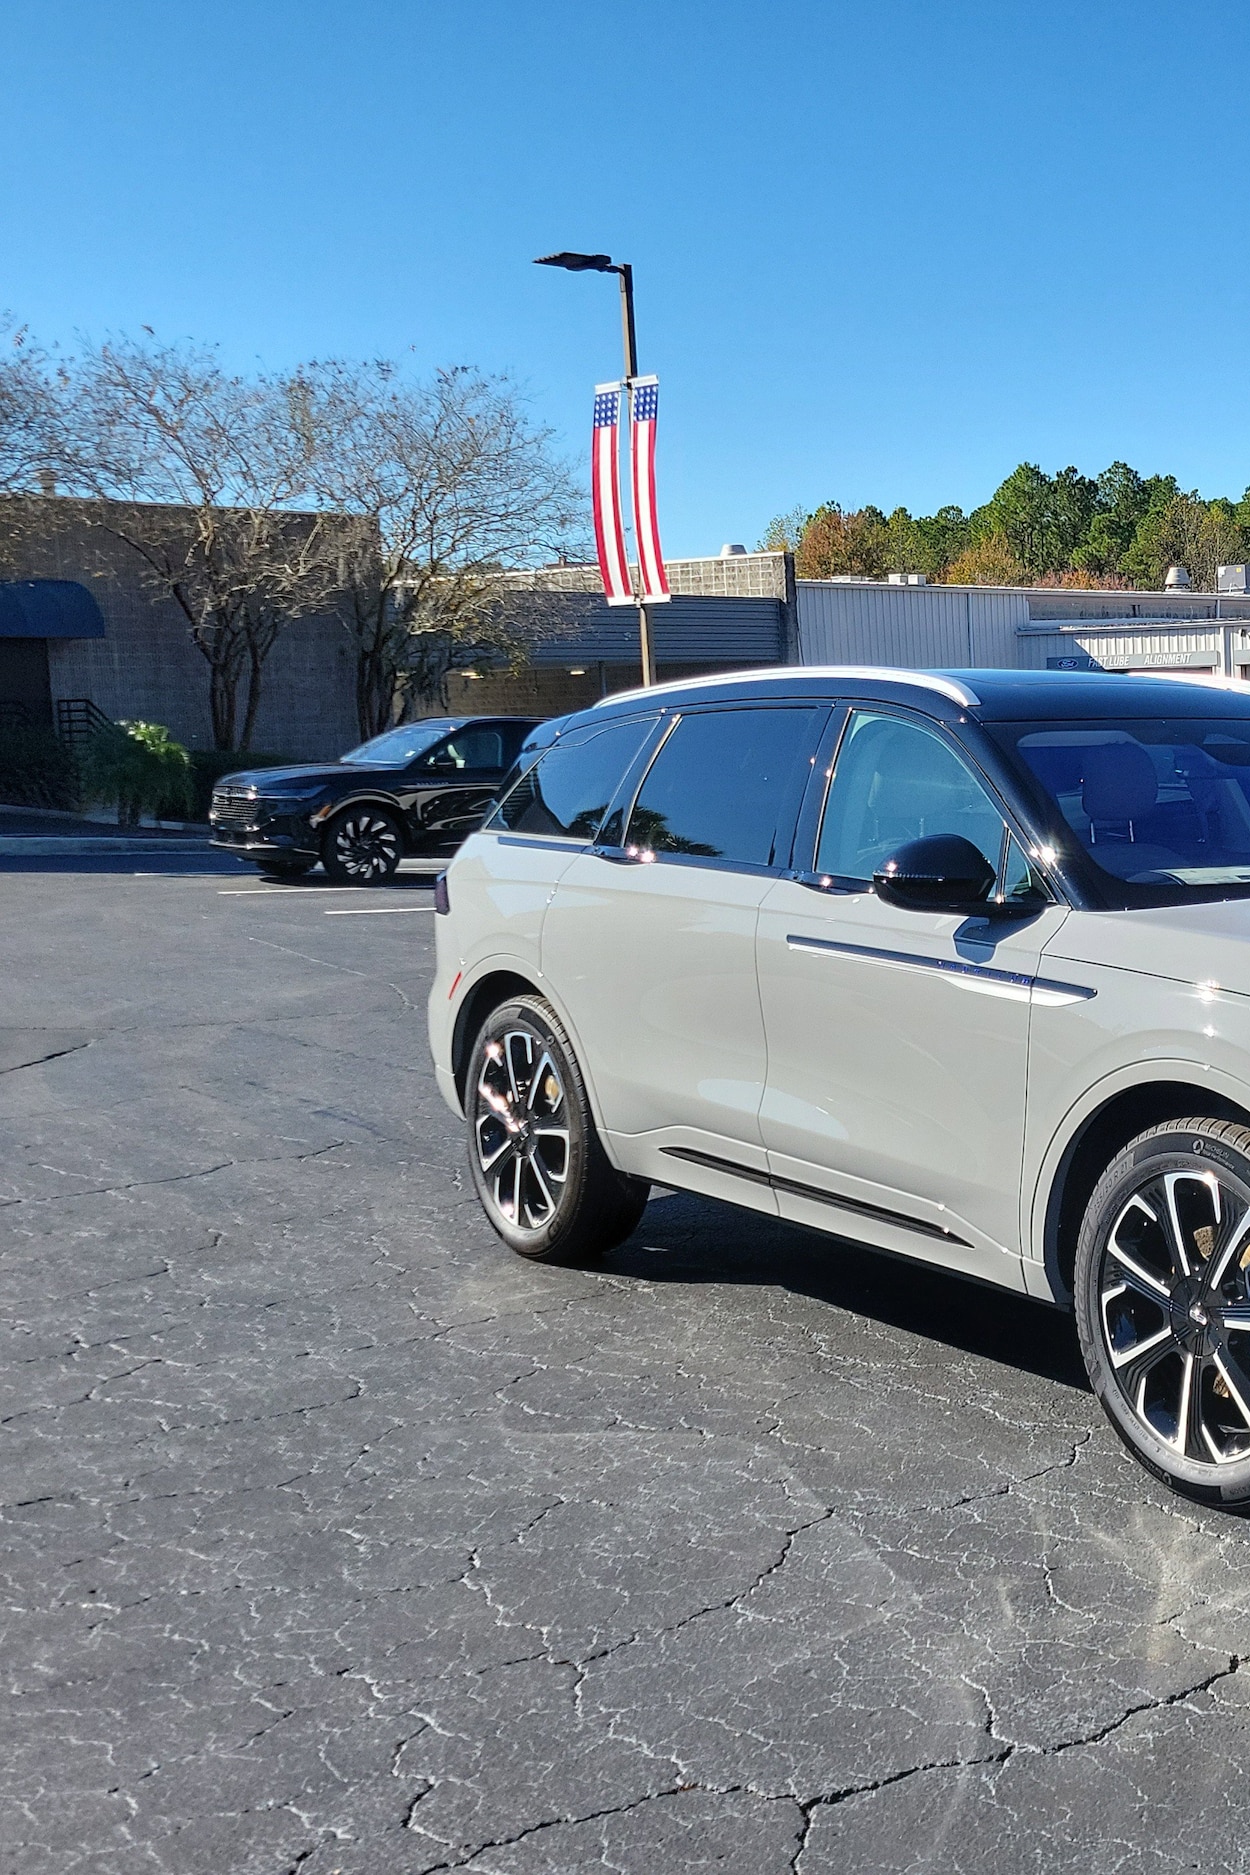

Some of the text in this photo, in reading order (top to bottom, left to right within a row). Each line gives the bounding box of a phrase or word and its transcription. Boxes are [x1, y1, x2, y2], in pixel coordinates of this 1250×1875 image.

[1088, 656, 1130, 668] FAST LUBE
[1143, 653, 1191, 665] ALIGNMENT
